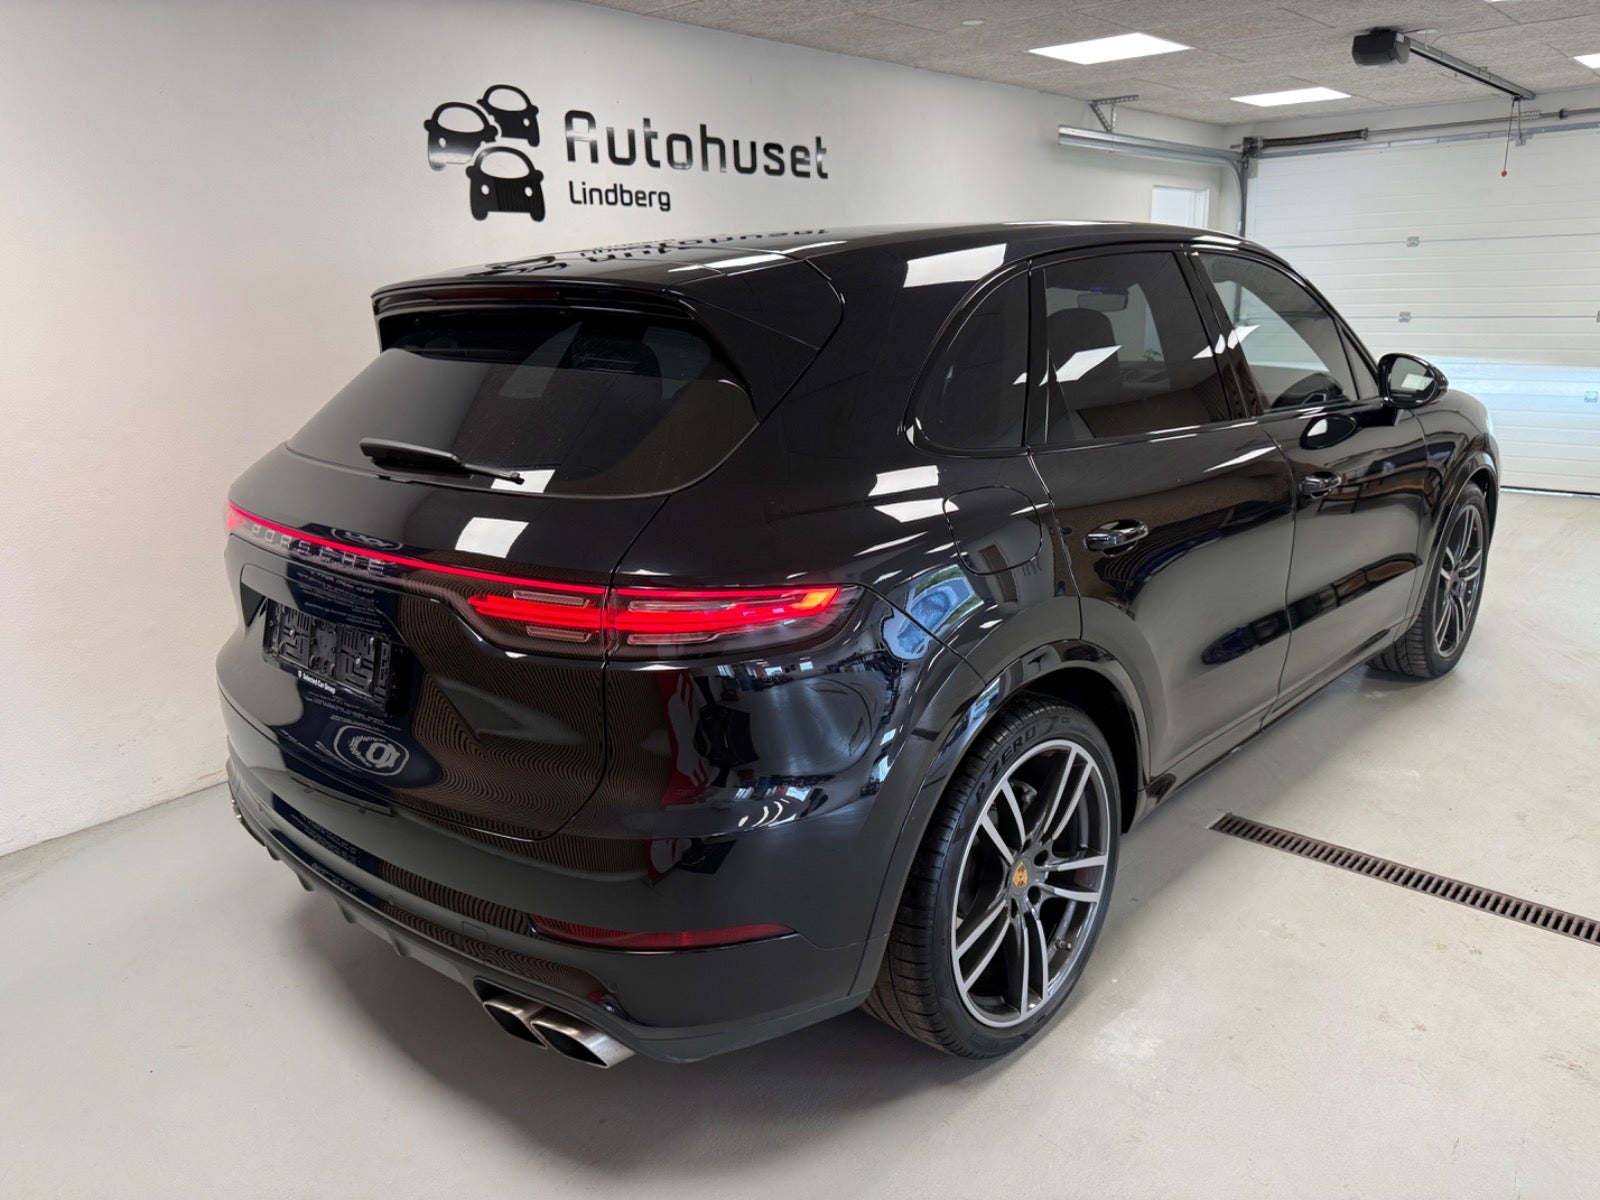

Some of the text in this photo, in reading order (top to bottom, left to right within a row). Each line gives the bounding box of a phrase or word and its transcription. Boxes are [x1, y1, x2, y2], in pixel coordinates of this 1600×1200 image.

[565, 109, 828, 179] Autohuset
[569, 181, 670, 211] Lindberg
[251, 522, 385, 575] PORSCHE
[989, 726, 1036, 782] ZERO
